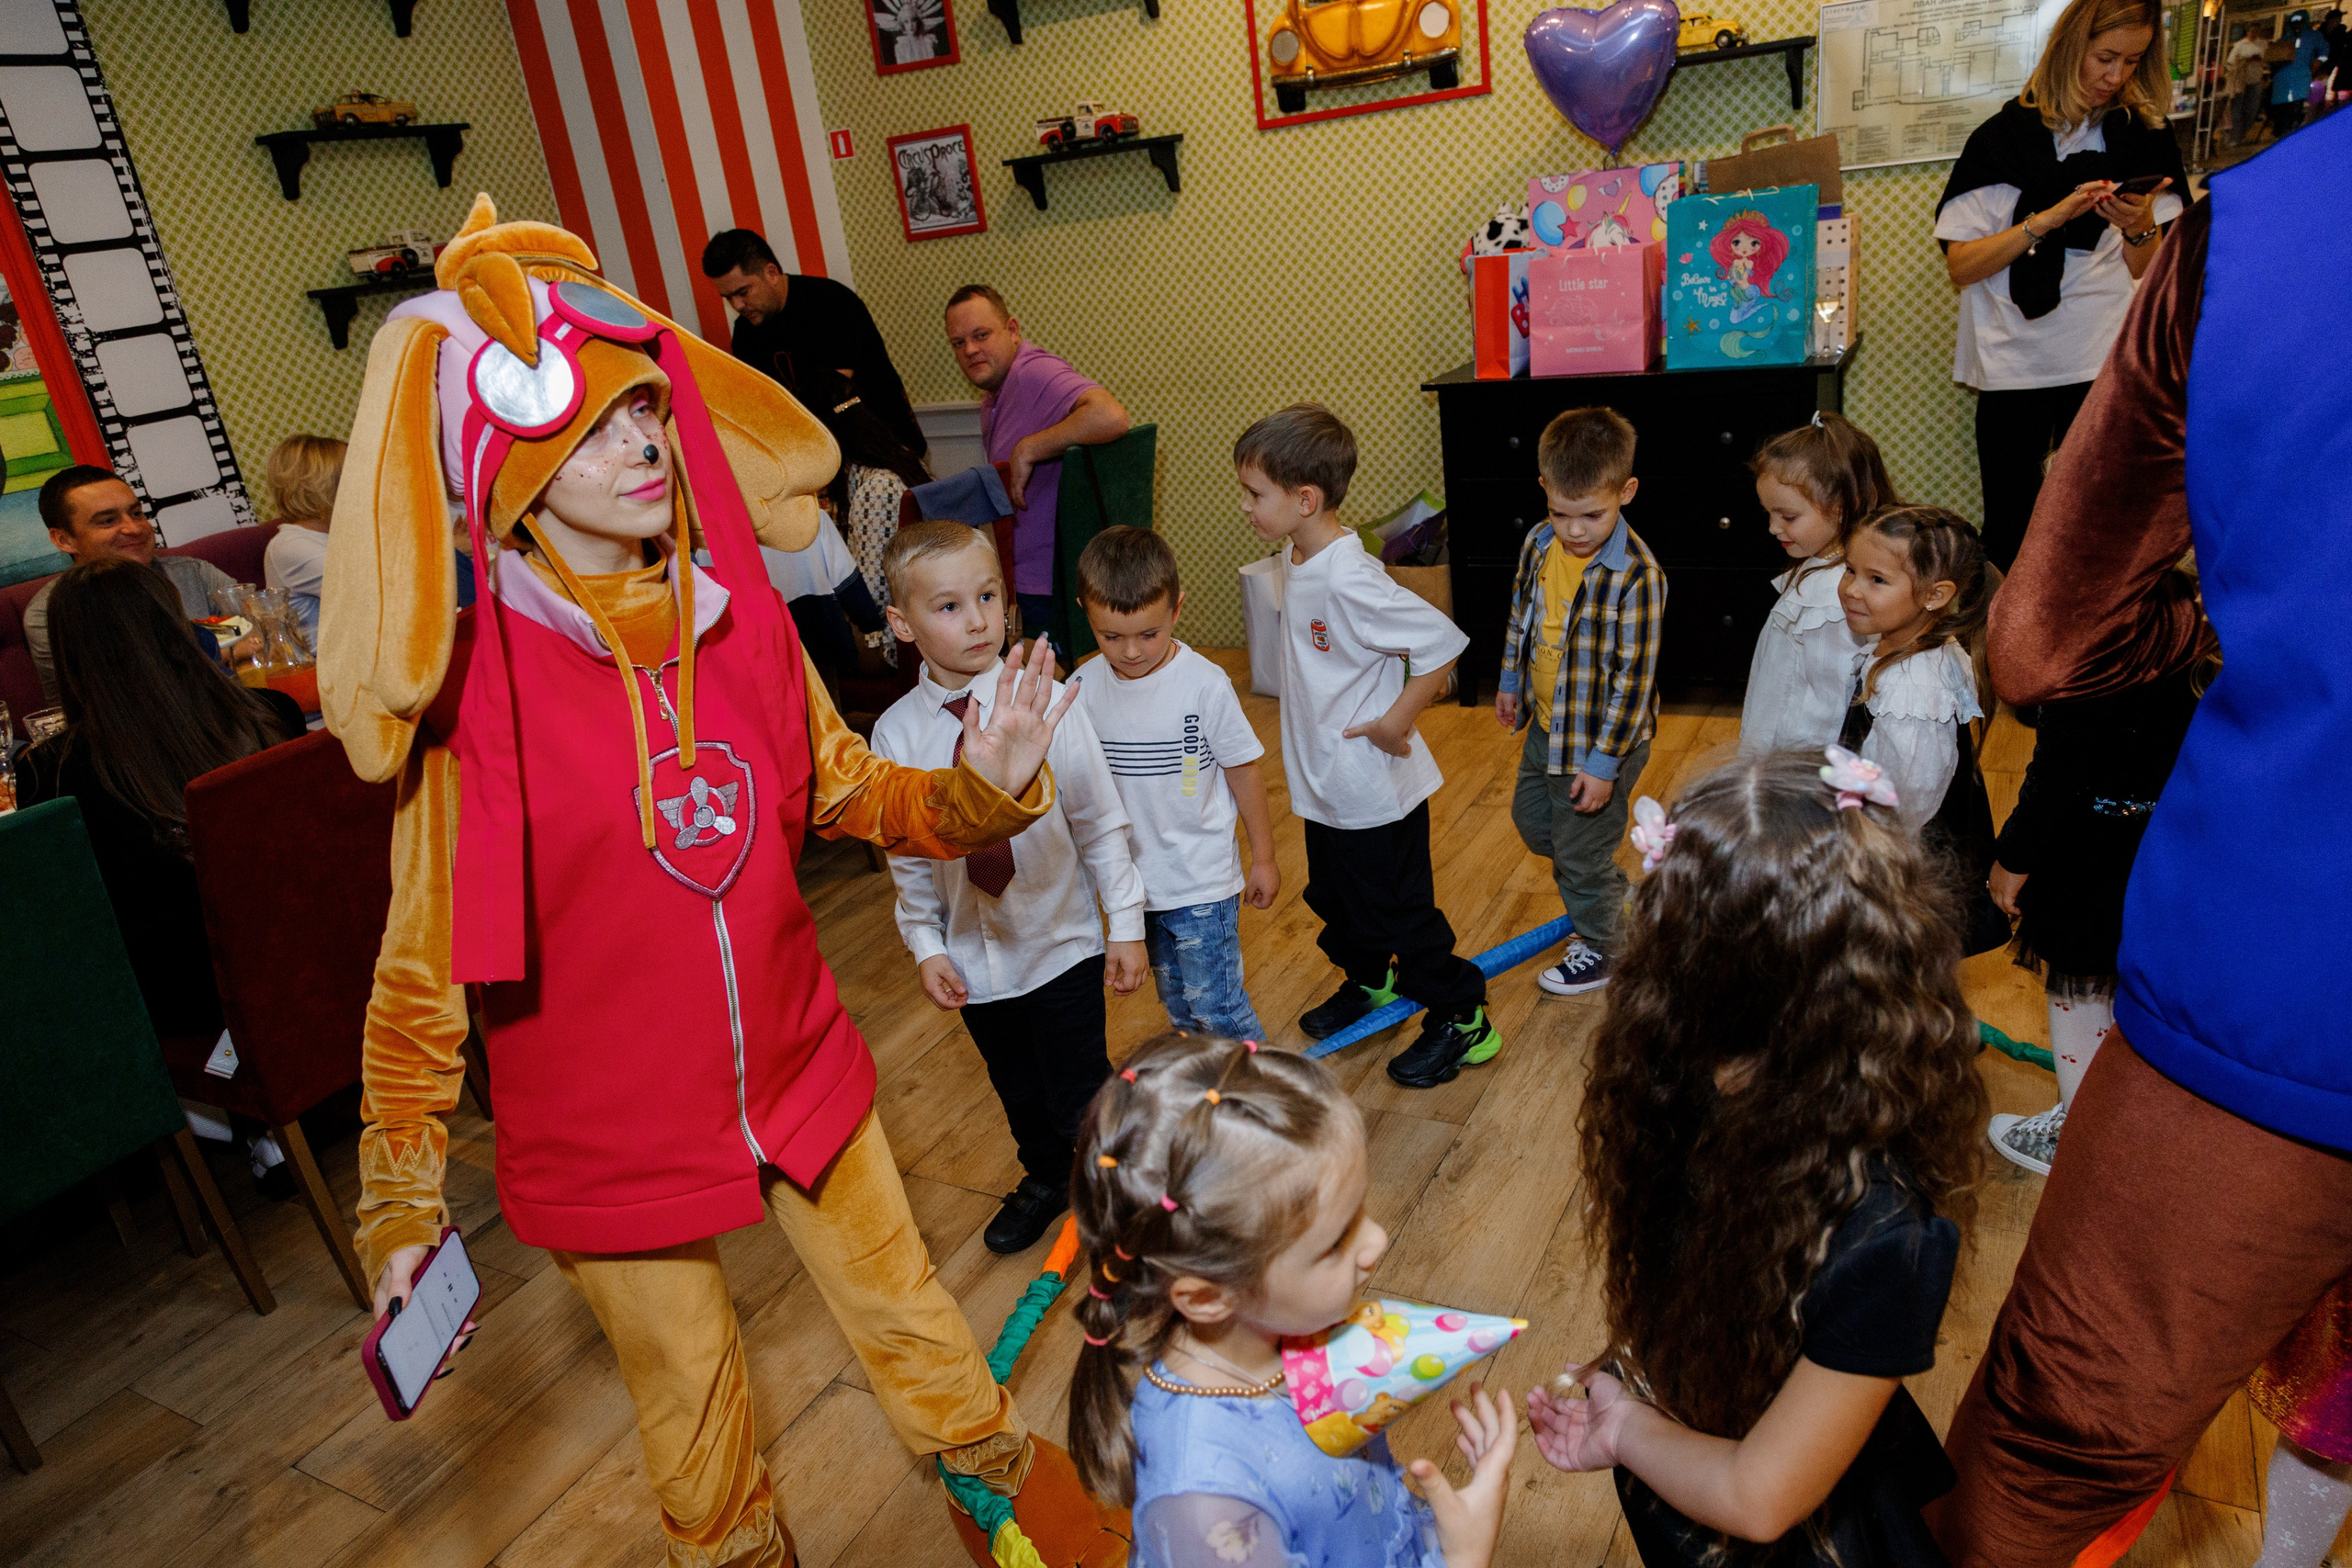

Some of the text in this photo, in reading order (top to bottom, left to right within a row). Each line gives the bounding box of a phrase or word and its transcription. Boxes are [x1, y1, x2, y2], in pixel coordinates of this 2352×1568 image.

[1588, 277, 1609, 290] star
[1182, 714, 1200, 797] GOOD MOOD
